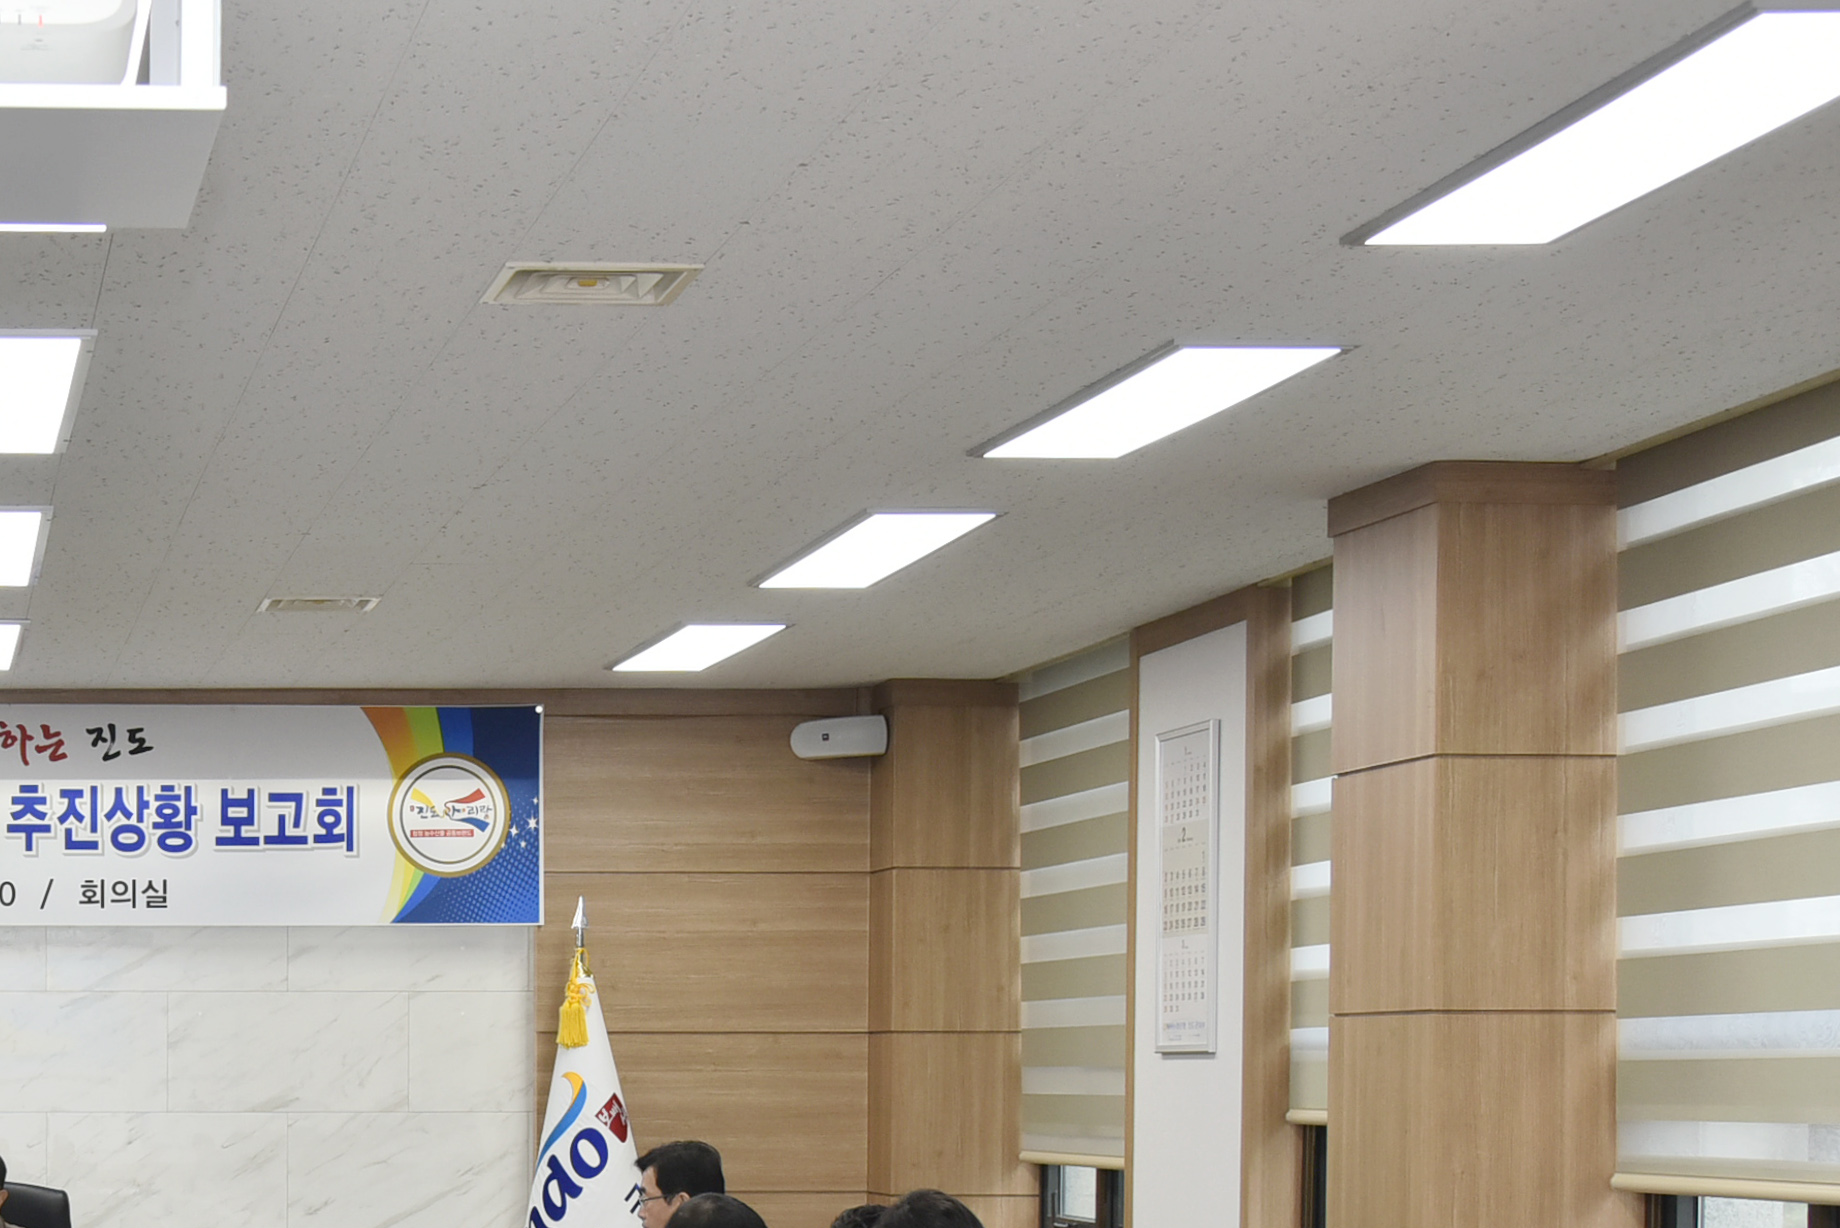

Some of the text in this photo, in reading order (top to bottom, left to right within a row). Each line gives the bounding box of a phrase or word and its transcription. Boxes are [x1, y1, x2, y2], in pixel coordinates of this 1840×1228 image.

[86, 722, 154, 762] 진도
[5, 784, 199, 854] 추진상황
[214, 784, 356, 854] 보고회
[78, 878, 169, 910] 회의실
